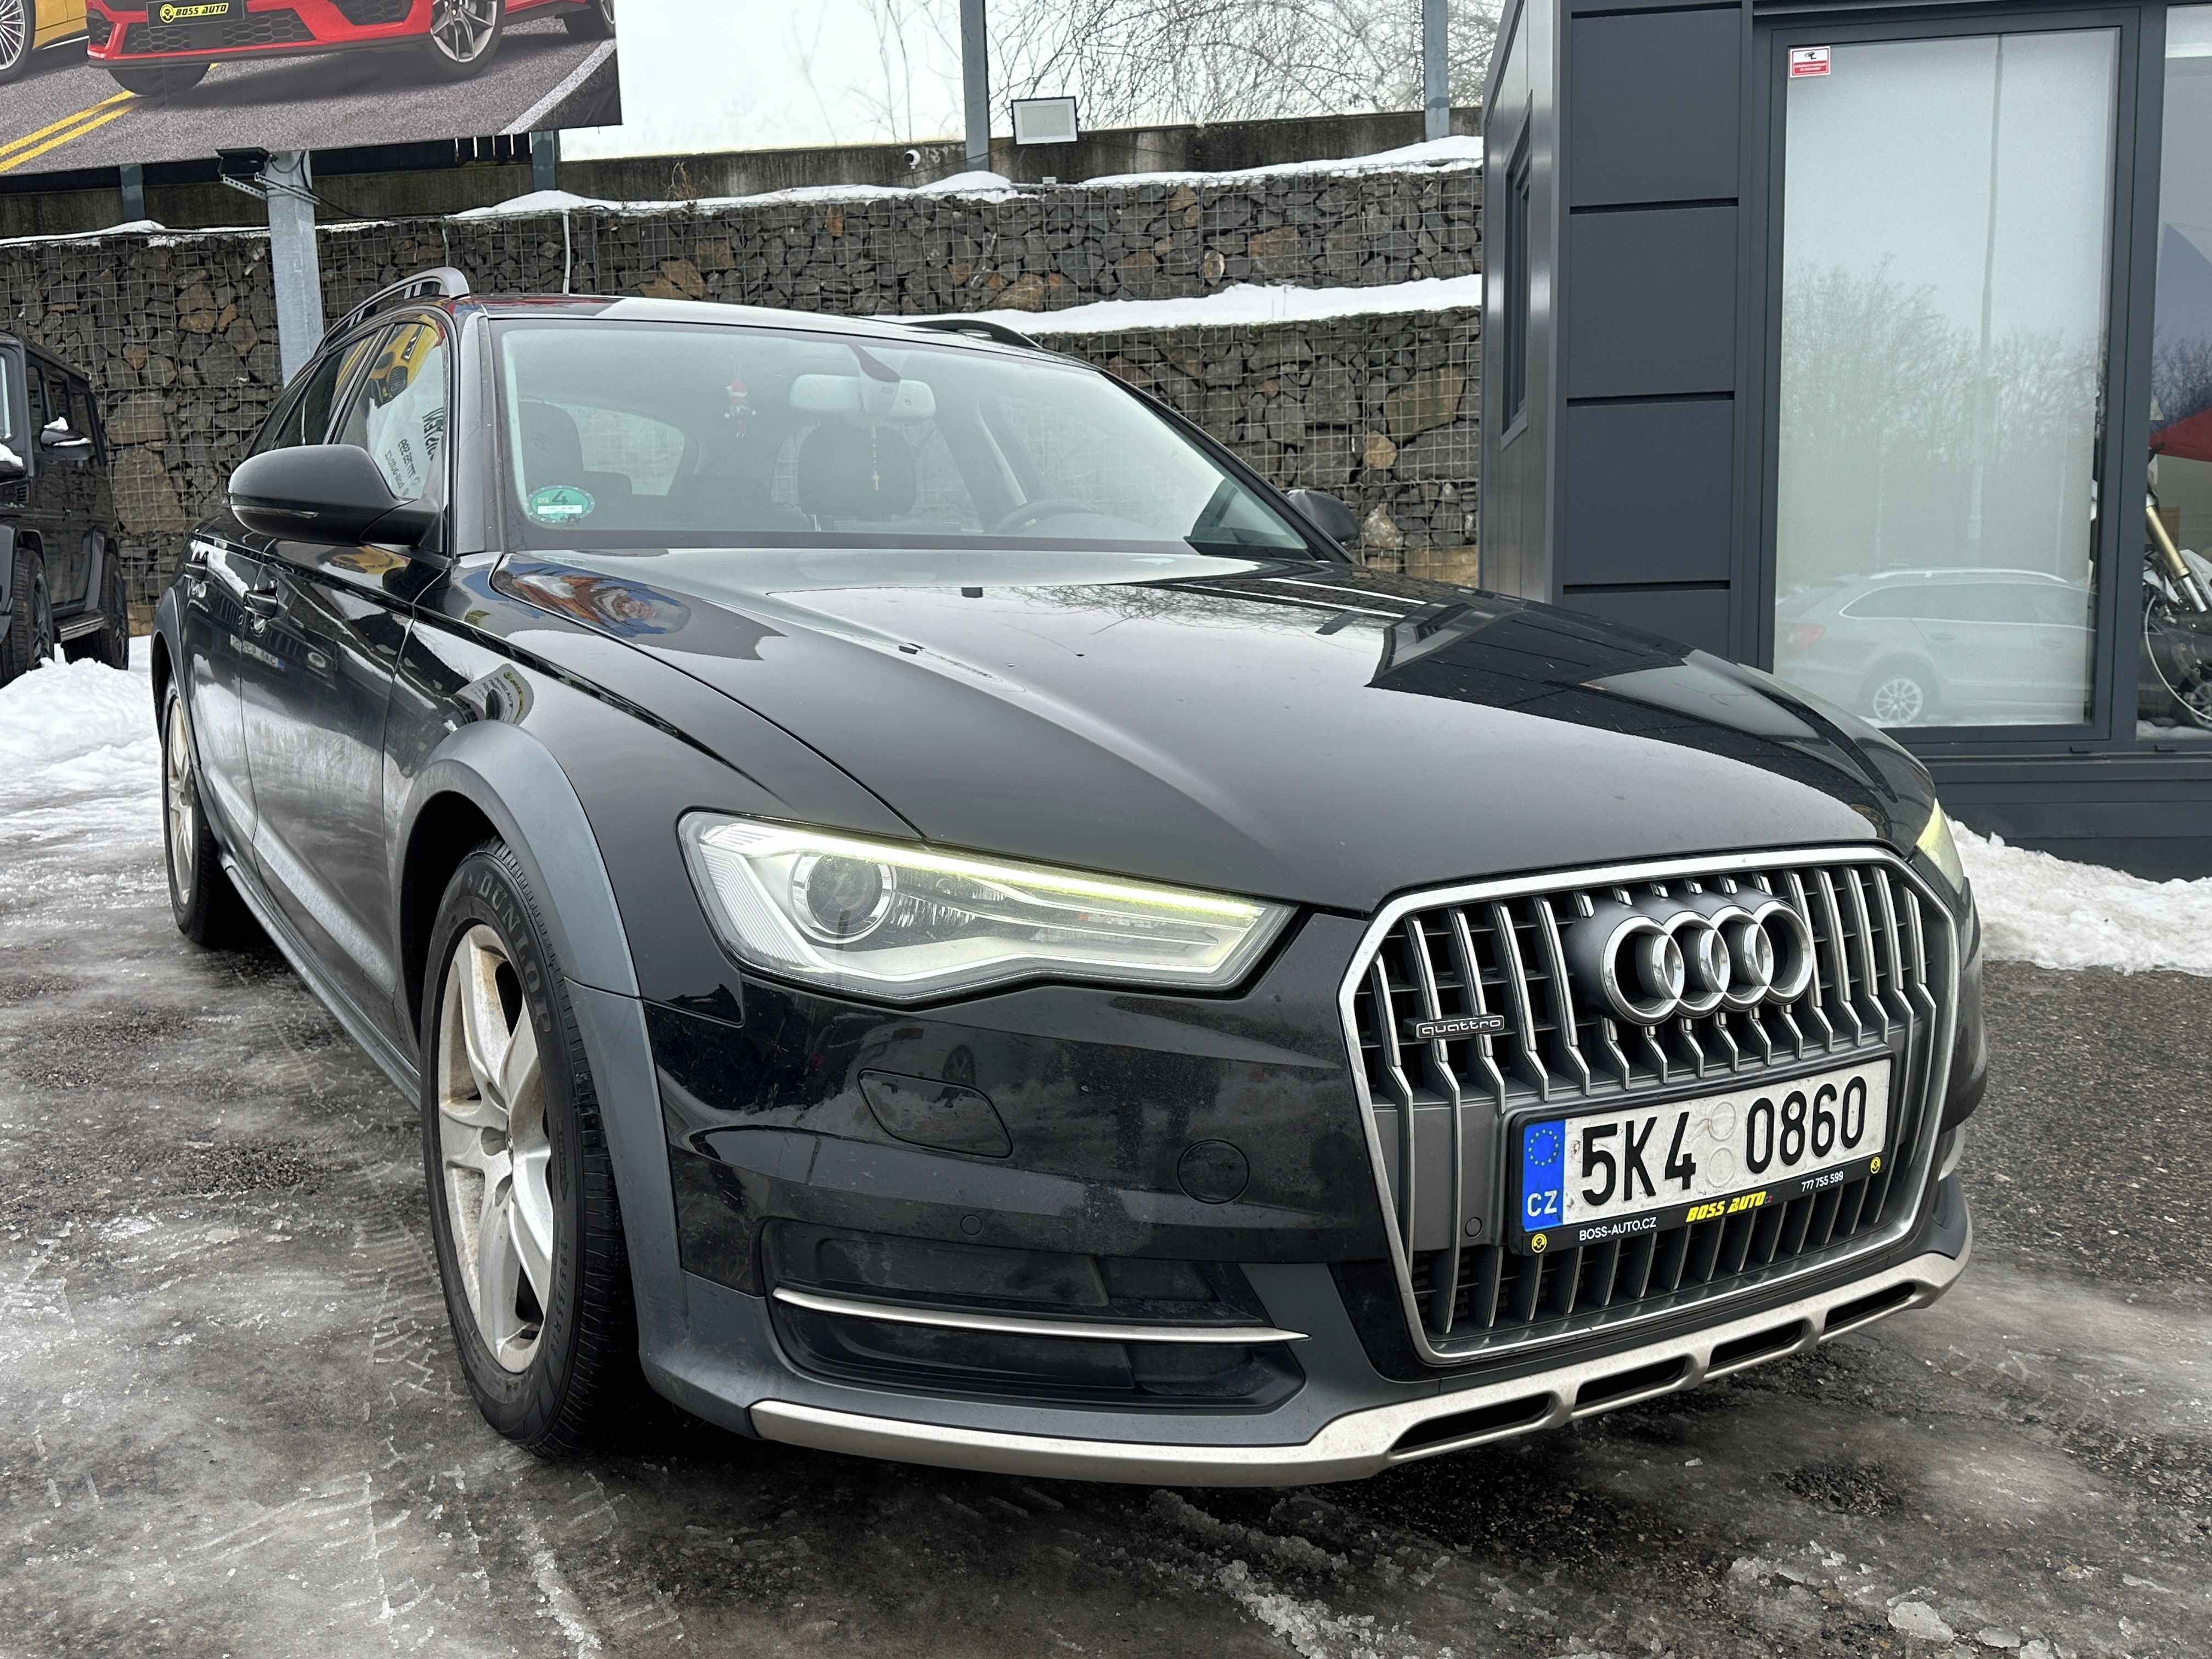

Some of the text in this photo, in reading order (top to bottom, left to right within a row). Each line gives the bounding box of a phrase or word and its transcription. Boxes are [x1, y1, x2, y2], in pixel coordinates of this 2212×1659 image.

[176, 4, 227, 16] BOSS AUTO
[552, 490, 568, 504] 4
[477, 870, 552, 1032] DUNLOP
[1421, 1020, 1501, 1036] quattro
[1582, 1076, 1867, 1206] 5K4 0860
[1802, 1171, 1843, 1192] 777 755 599
[1527, 1190, 1558, 1217] CZ
[1686, 1200, 1725, 1222] BOSS
[1727, 1191, 1767, 1214] AUTO
[1579, 1217, 1656, 1241] BOSS-AUTO.CZ
